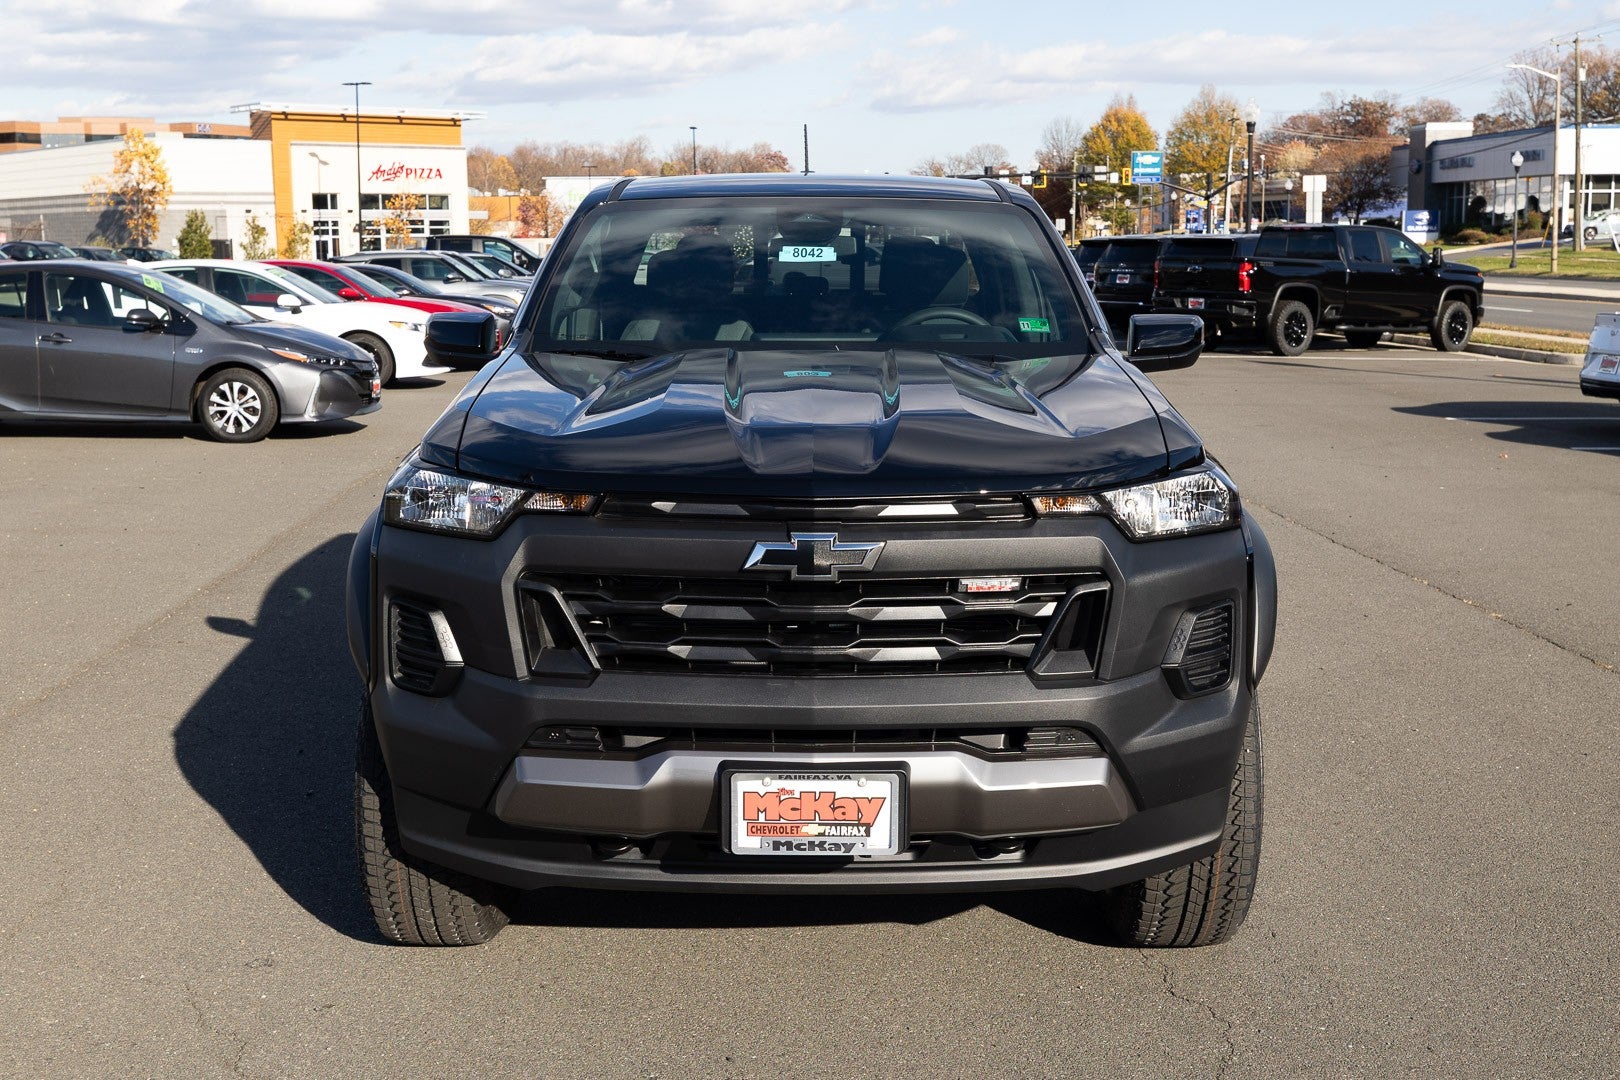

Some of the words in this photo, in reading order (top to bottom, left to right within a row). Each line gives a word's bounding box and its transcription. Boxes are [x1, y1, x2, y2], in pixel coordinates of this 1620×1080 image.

[405, 168, 443, 179] PIZZA
[792, 247, 824, 258] 8042
[743, 791, 886, 827] McKay
[750, 825, 800, 835] CHEVROLET
[825, 826, 866, 837] FAIRFAX
[772, 840, 856, 853] McKay
